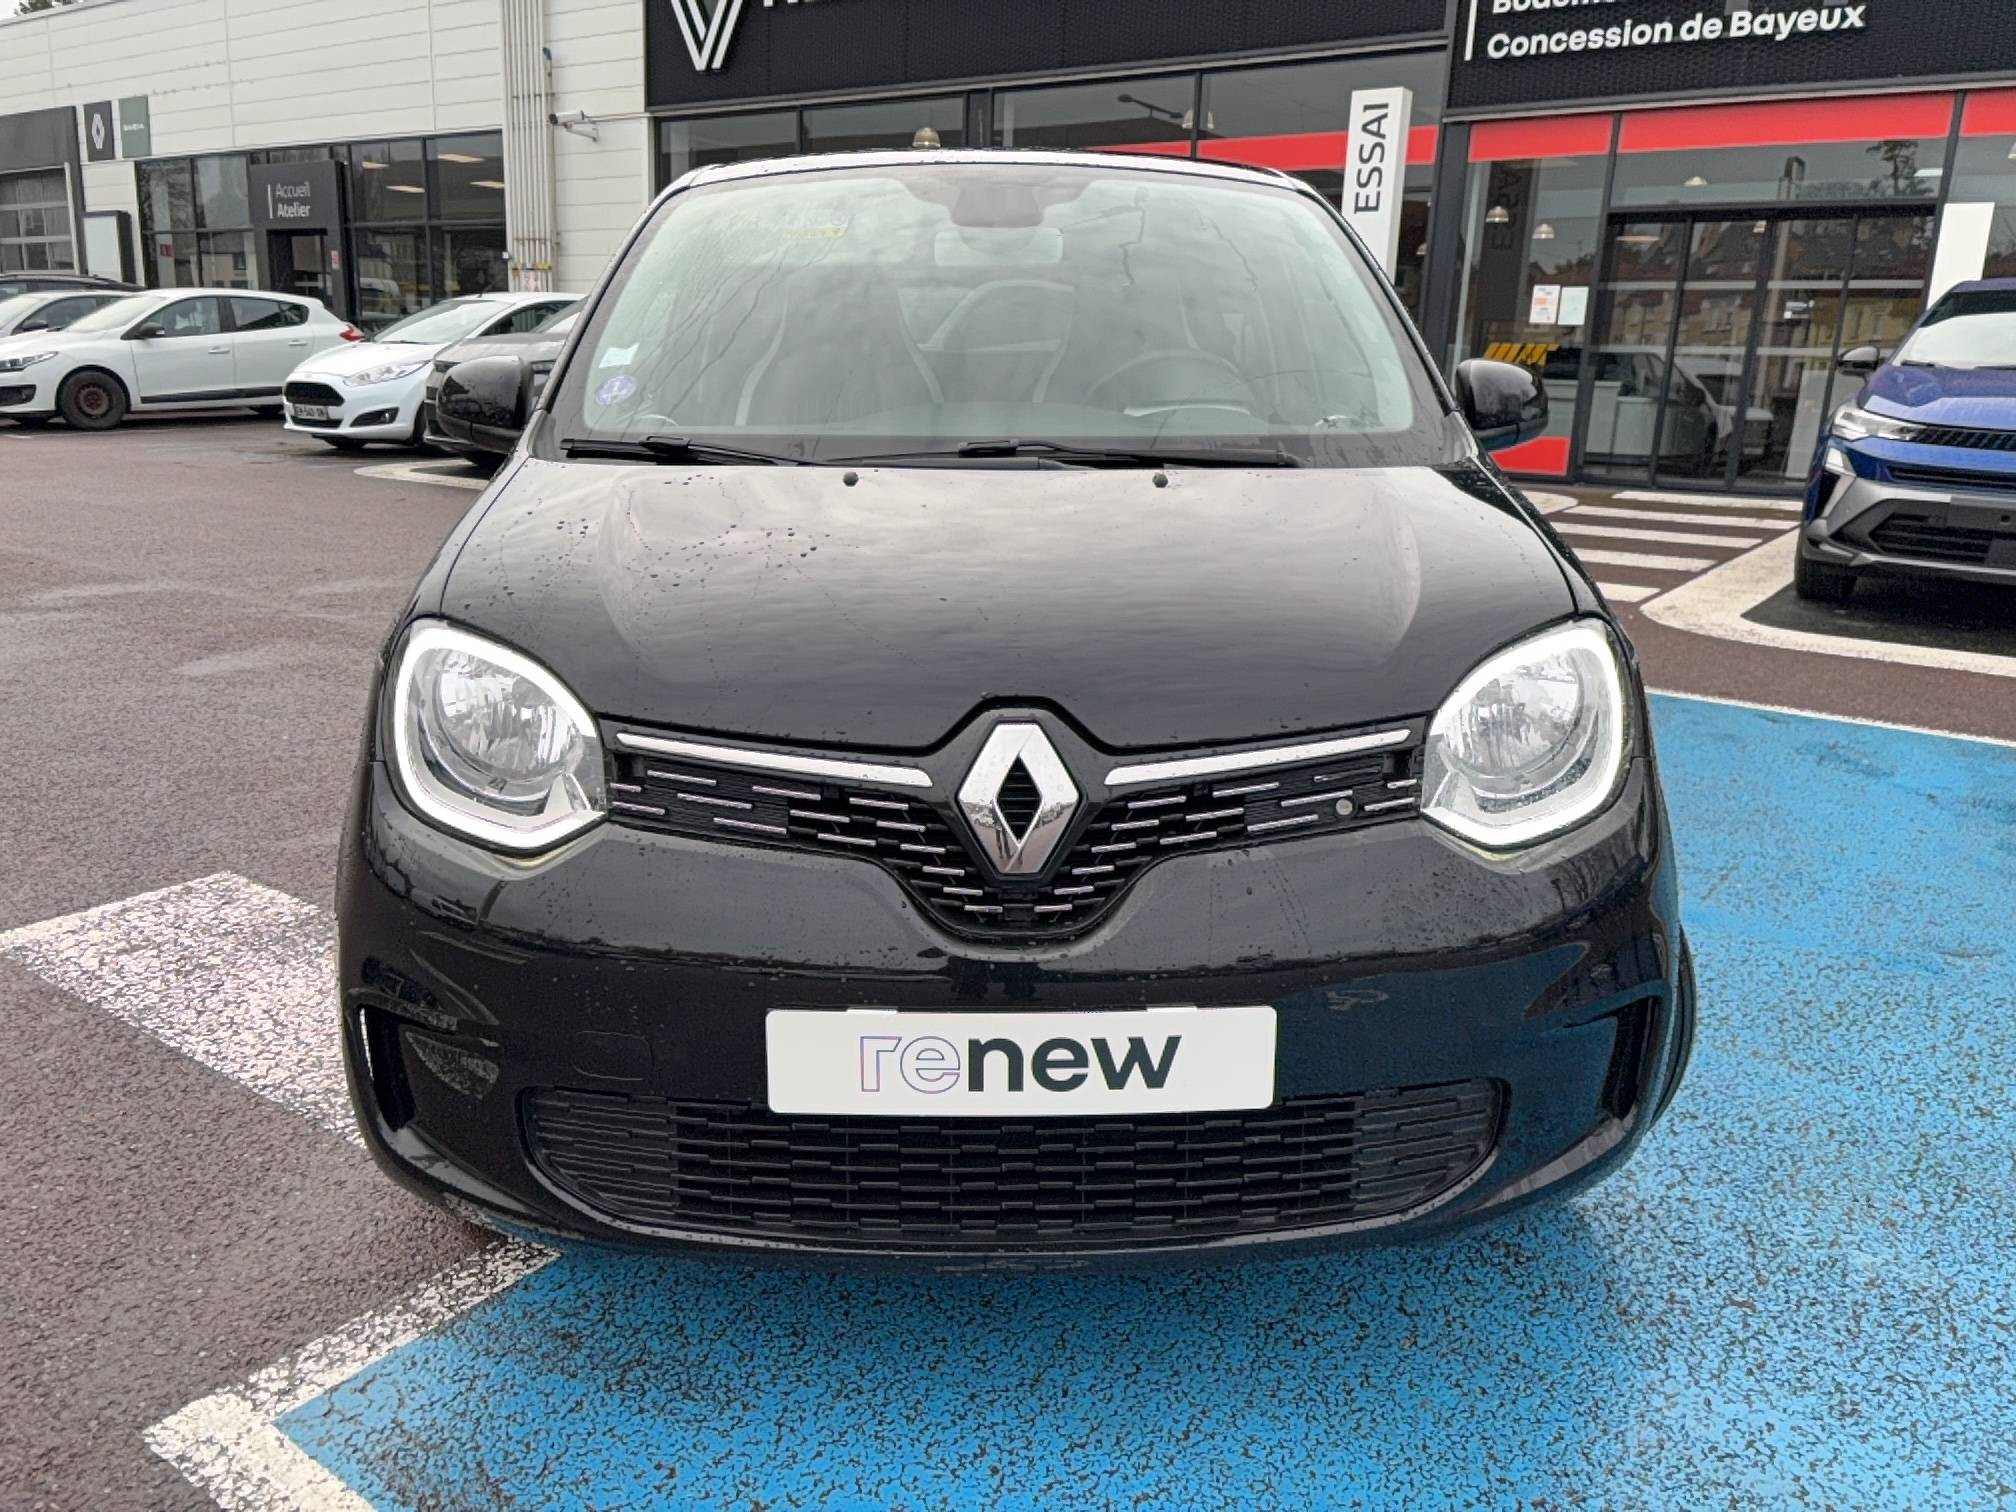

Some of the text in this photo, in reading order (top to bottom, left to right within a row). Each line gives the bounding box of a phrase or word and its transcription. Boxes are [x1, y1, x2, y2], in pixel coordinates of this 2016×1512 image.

[1487, 5, 1867, 59] Concession de Bayeux
[1353, 102, 1390, 214] ESSAI
[275, 181, 311, 198] Accueil
[277, 201, 311, 217] Atelier
[859, 1034, 1183, 1094] renew
